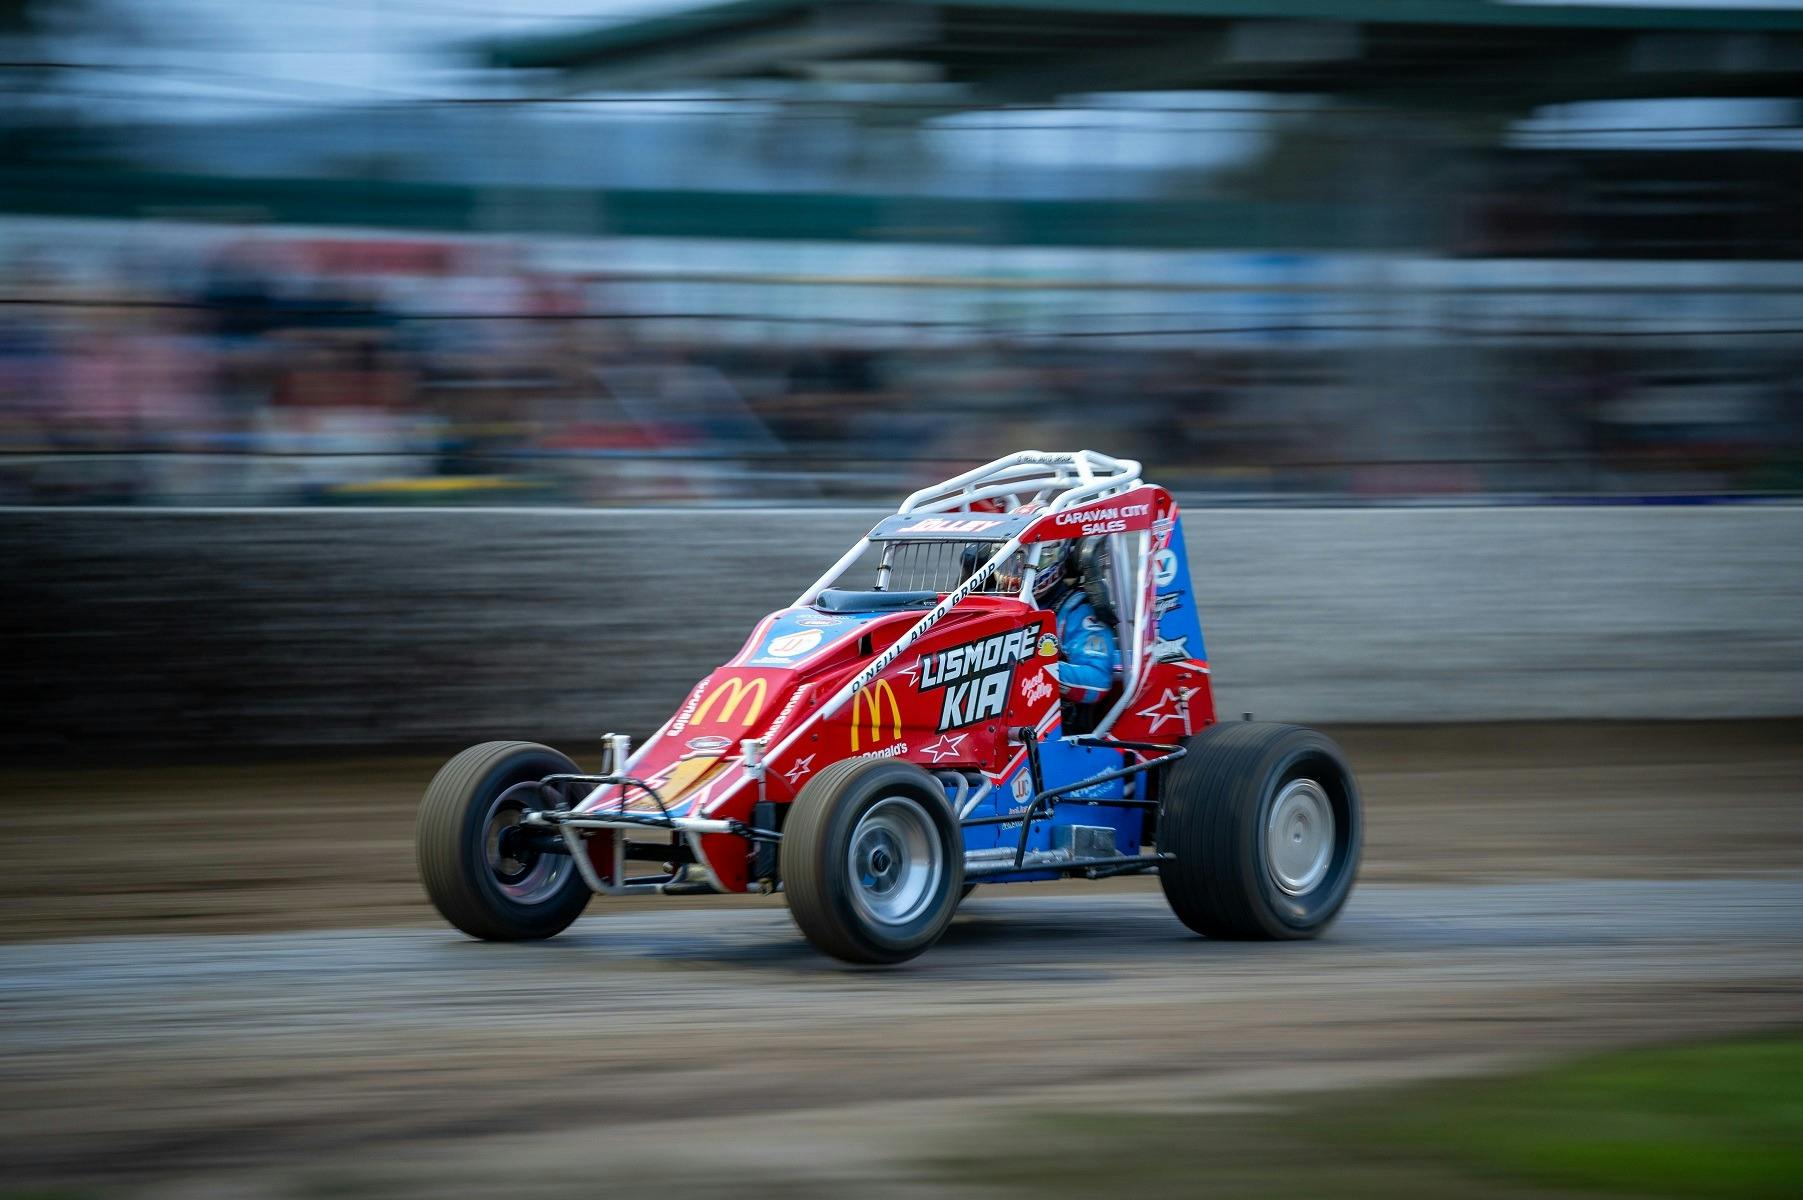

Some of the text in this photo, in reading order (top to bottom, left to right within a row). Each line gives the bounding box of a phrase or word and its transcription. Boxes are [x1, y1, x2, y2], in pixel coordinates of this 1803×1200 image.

[1055, 504, 1150, 526] CARAVAN CITY
[1081, 520, 1127, 535] SALES
[909, 606, 946, 643] AUTO
[952, 562, 996, 607] GROUP
[920, 624, 1041, 689] LISMORE
[938, 670, 1011, 731] KIA
[848, 742, 908, 760] Donald's
